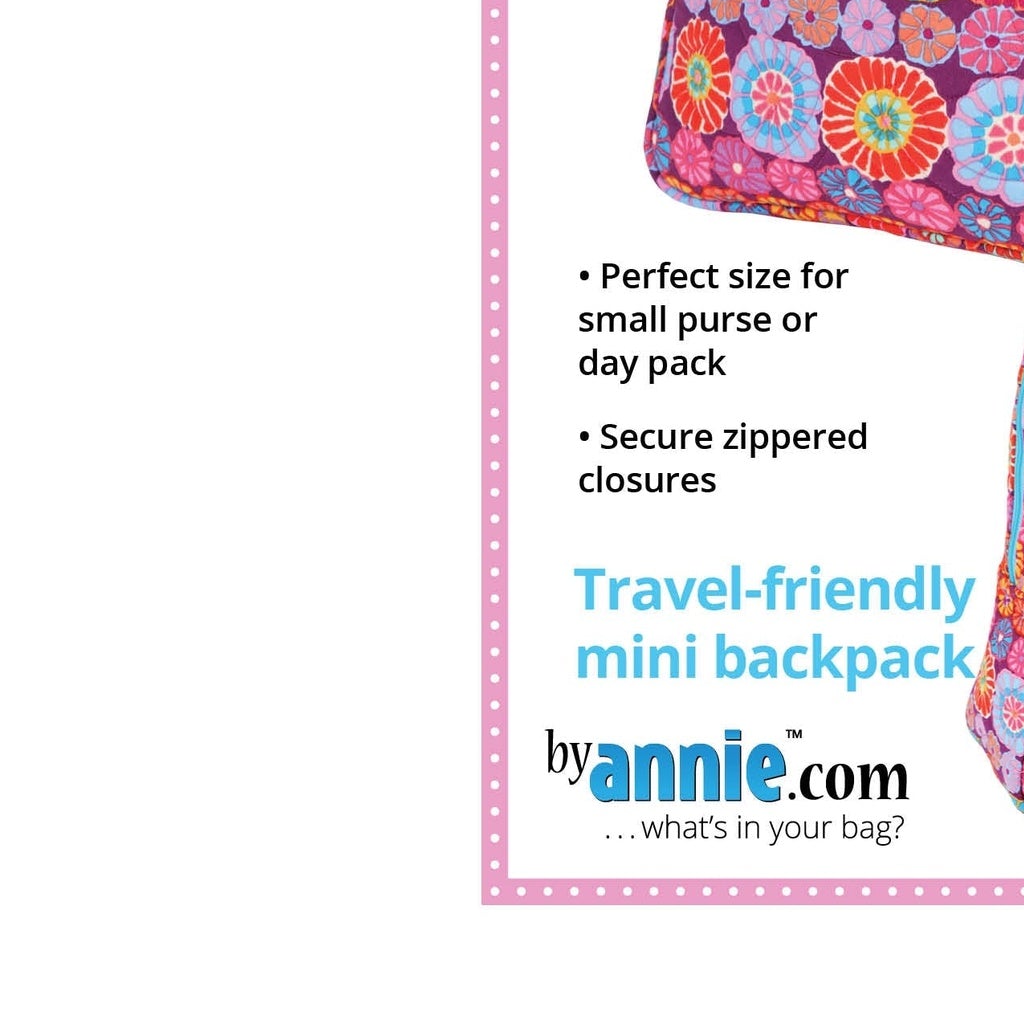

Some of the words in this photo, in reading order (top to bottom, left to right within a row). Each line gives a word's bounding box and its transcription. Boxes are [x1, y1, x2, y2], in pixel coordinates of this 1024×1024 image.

[602, 261, 719, 289] Perfect
[729, 261, 791, 289] size
[800, 261, 849, 289] for
[578, 304, 666, 333] small
[678, 311, 772, 341] purse
[782, 311, 818, 333] or
[579, 348, 639, 385] day
[649, 348, 727, 385] pack
[600, 423, 713, 450] Secure
[723, 421, 867, 459] zippered
[579, 465, 717, 493] closures
[574, 565, 975, 624] Travel-friendly
[578, 634, 696, 679] mini
[716, 633, 974, 690] backpack
[737, 814, 760, 839] in
[769, 820, 833, 847] your
[842, 814, 905, 847] bag?
